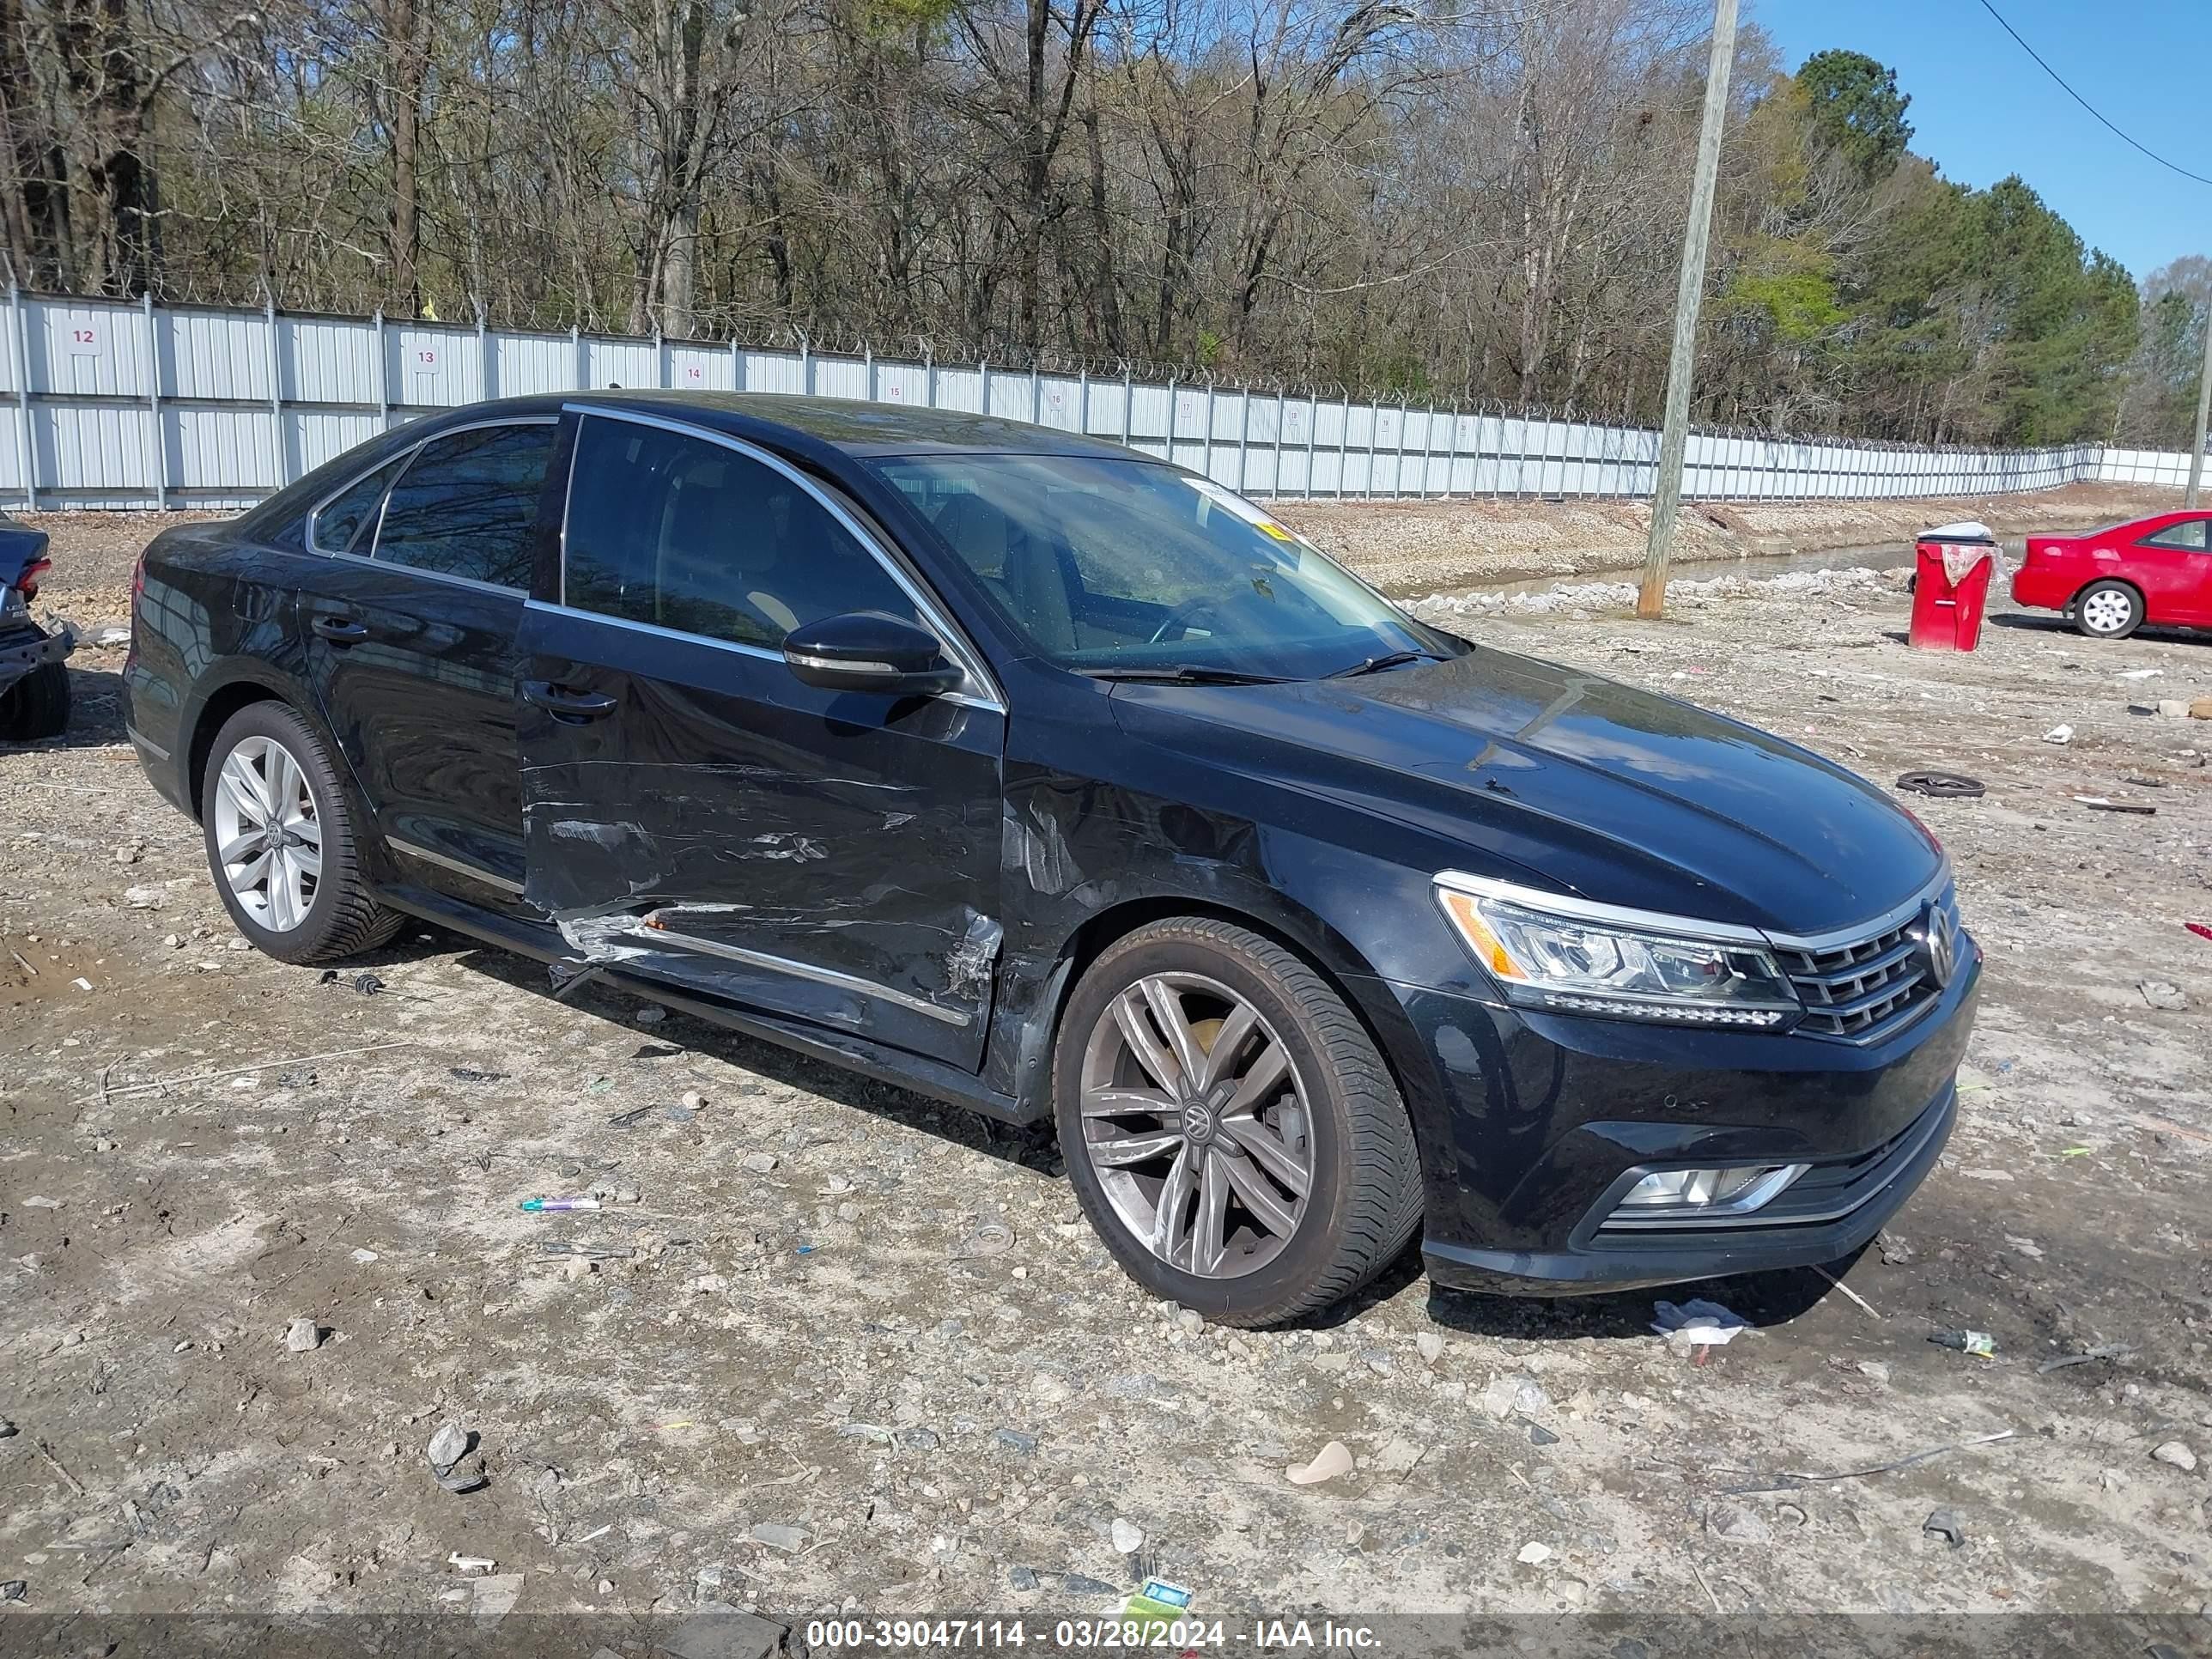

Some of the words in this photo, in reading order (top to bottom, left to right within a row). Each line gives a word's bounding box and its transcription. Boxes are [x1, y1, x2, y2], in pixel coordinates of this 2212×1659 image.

[72, 330, 94, 343] 12
[418, 351, 434, 362] 13
[687, 368, 701, 379] 14
[890, 387, 900, 396] 15
[1052, 395, 1060, 404] 16
